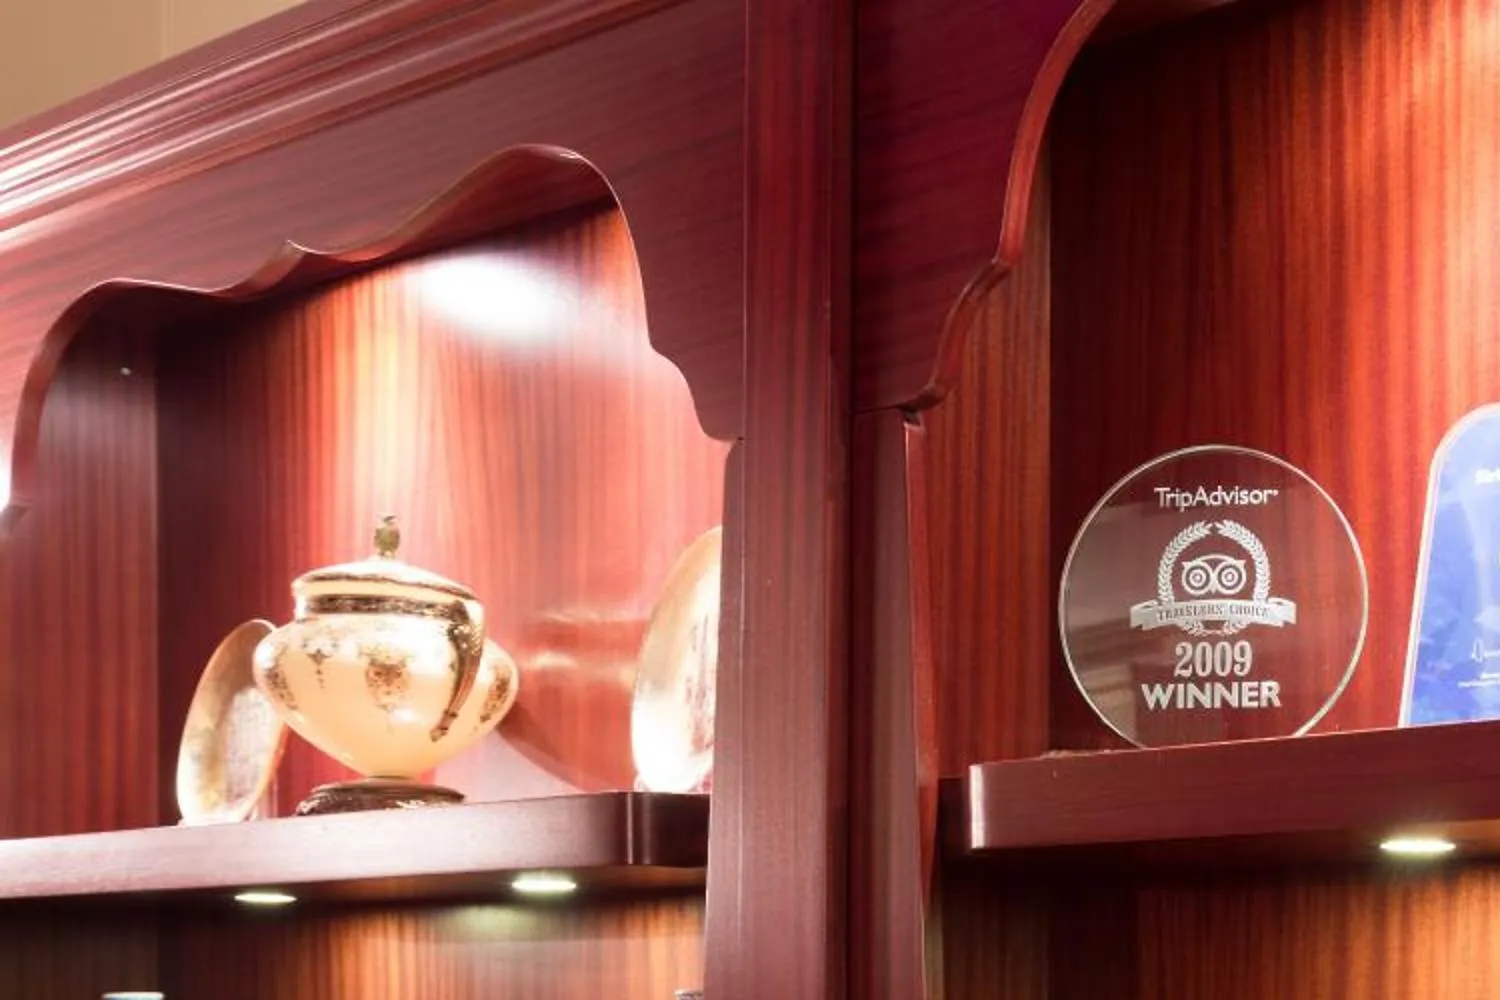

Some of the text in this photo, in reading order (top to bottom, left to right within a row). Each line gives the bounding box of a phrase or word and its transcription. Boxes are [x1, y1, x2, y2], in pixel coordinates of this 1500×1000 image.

[1154, 486, 1273, 512] TripAdvisor
[1174, 641, 1252, 677] 2009
[1141, 680, 1282, 711] WINNER
